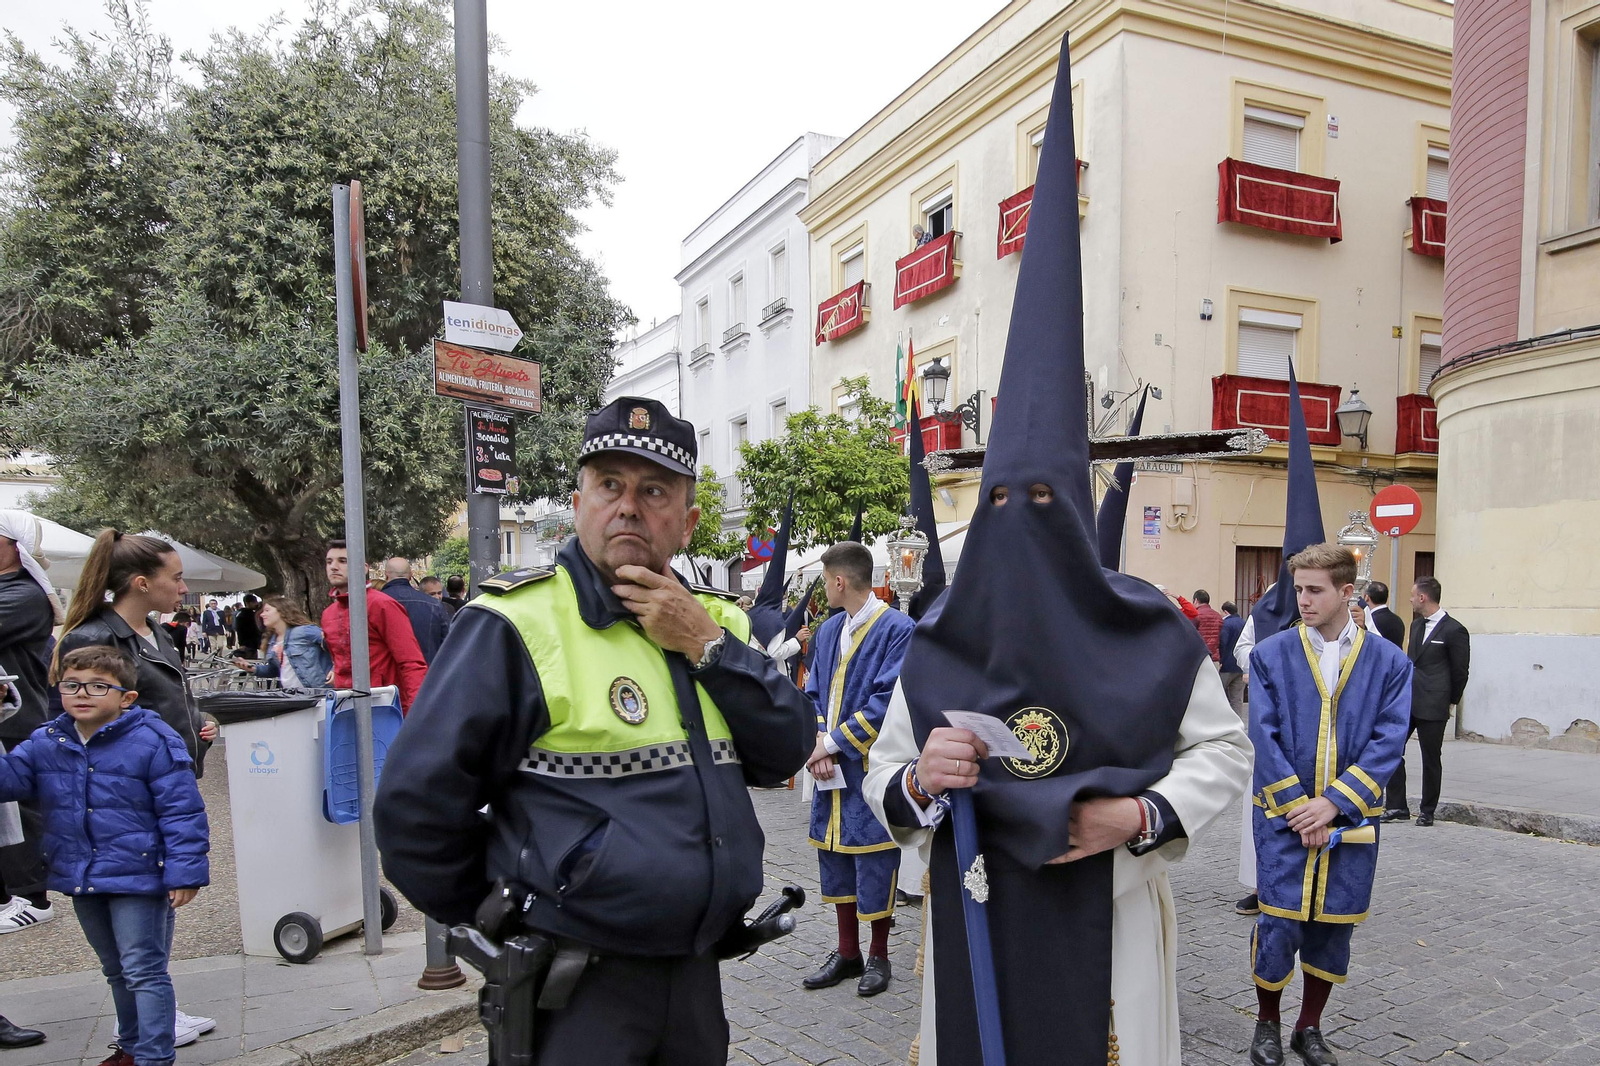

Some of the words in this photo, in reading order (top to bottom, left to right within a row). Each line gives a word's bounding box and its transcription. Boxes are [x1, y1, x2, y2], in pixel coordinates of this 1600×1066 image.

[447, 316, 520, 337] tenidiomas
[446, 350, 473, 370] Tu
[473, 359, 530, 382] Huerto
[439, 372, 479, 389] ALIMENTACIÓN,
[479, 380, 504, 394] FRUTERÍA,
[476, 432, 509, 444] Bocadillo
[248, 766, 279, 775] urbaser
